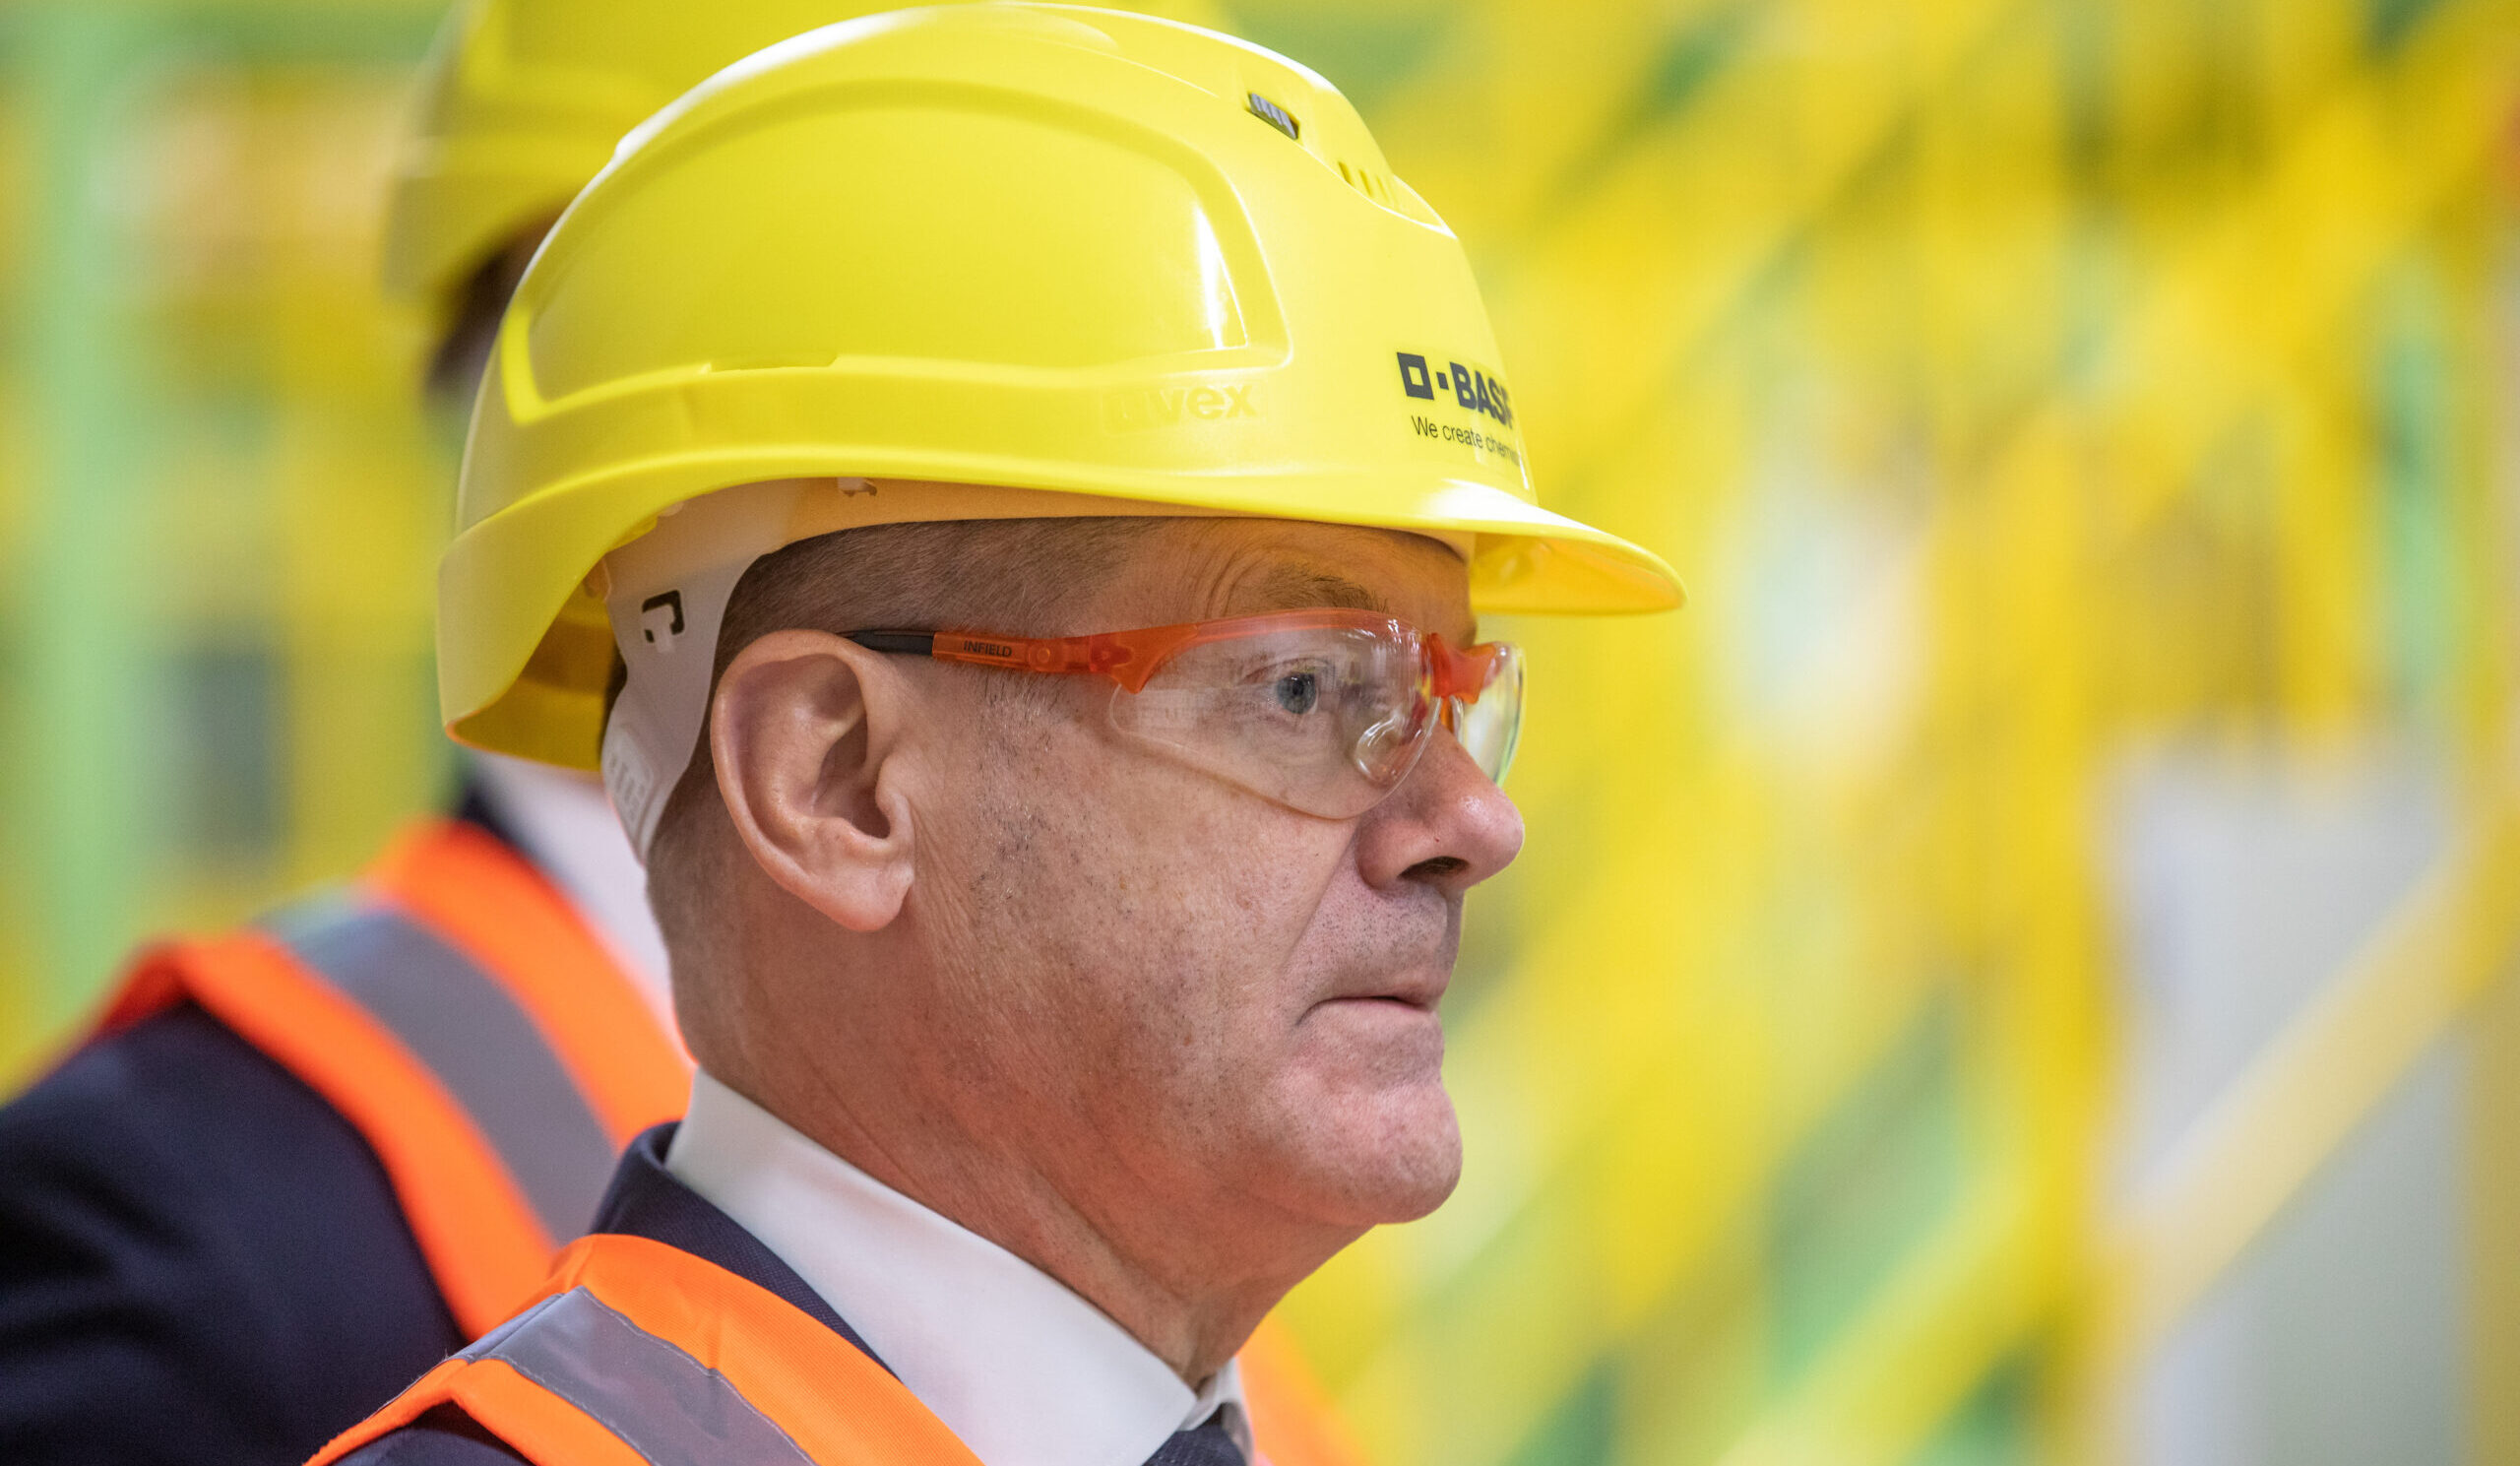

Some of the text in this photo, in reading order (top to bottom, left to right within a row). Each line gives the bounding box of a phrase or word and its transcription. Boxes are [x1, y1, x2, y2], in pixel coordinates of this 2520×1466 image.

[1411, 414, 1439, 438] We
[1442, 424, 1484, 449] create
[963, 640, 1013, 658] INFIELD
